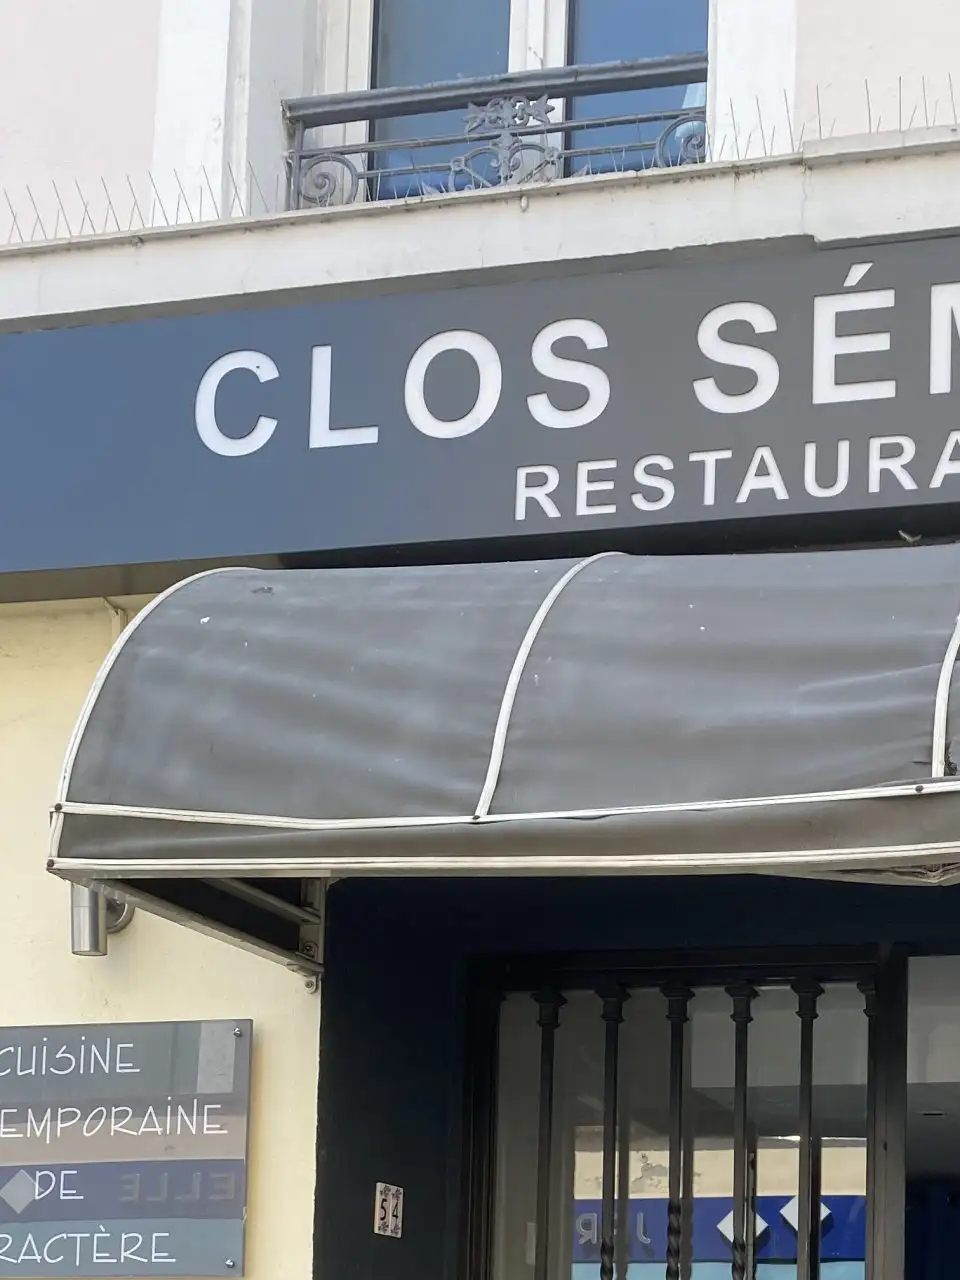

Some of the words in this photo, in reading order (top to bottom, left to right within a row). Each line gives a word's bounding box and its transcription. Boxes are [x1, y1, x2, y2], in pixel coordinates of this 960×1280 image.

[193, 319, 611, 457] CLOS
[34, 1170, 84, 1200] DE
[380, 1197, 399, 1221] 54
